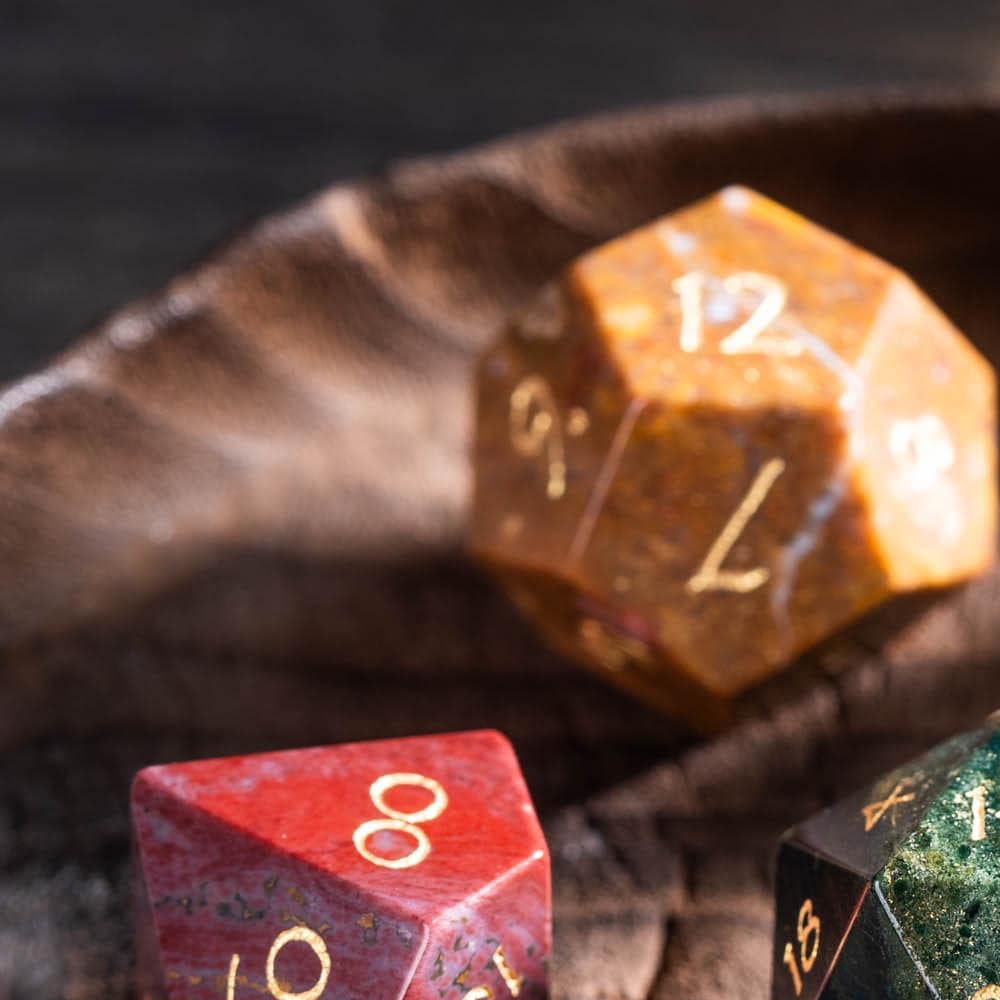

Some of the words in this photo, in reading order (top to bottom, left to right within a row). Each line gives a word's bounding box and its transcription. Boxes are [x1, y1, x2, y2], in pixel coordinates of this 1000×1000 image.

[672, 271, 803, 354] 12
[686, 456, 787, 593] 7
[782, 898, 823, 996] 18
